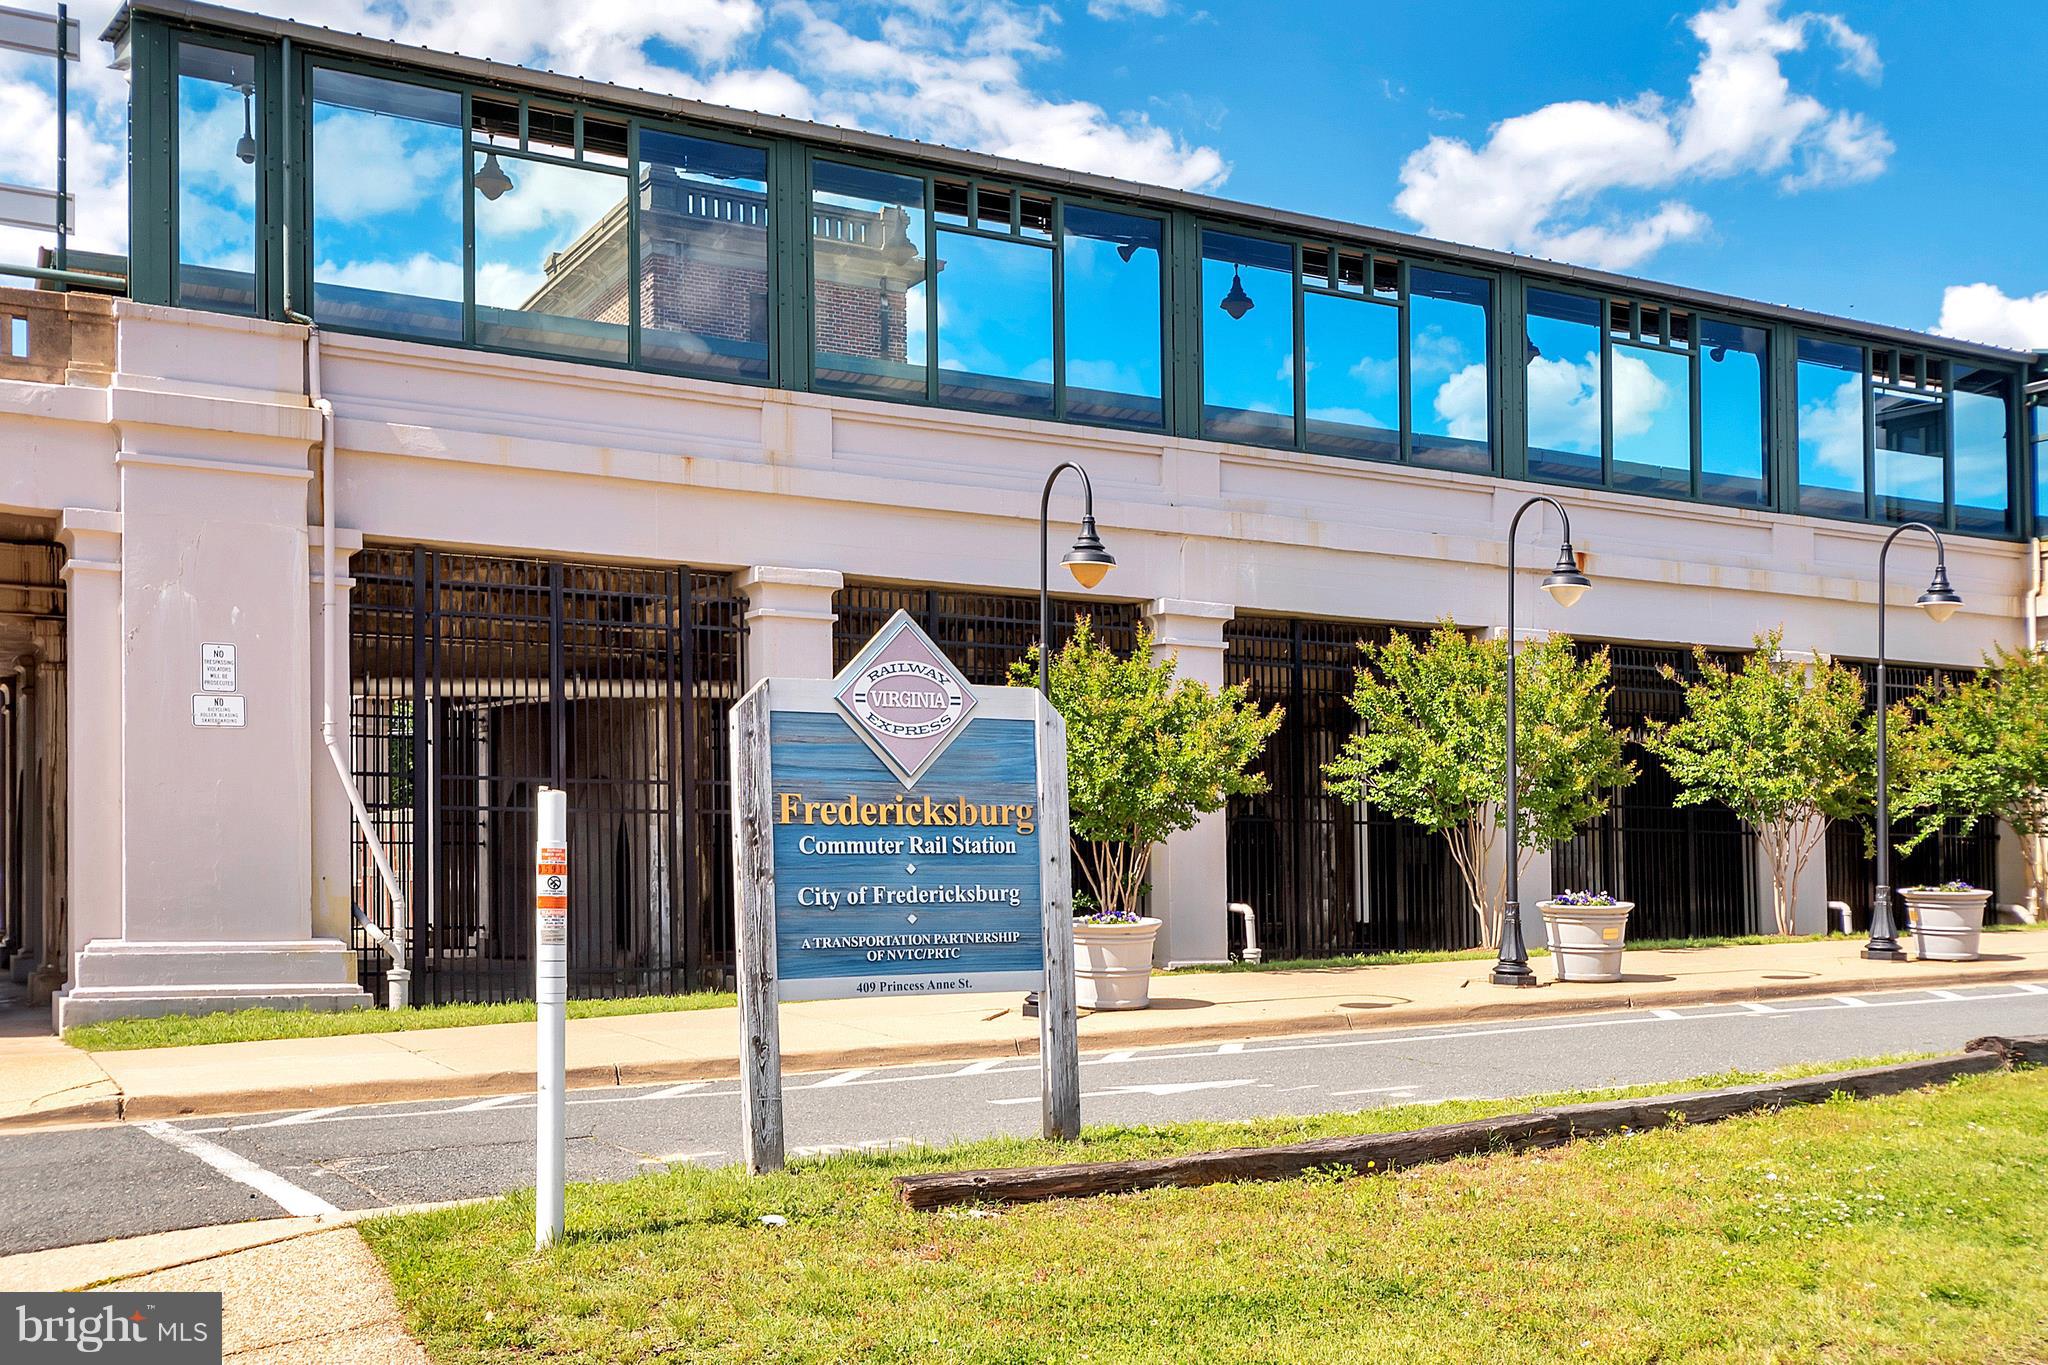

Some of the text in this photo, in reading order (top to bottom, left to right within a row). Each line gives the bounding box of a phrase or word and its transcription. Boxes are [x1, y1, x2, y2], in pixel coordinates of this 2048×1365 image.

[213, 650, 224, 658] NO
[867, 663, 951, 685] RAILWAY
[214, 698, 224, 706] NO
[870, 690, 947, 709] VIRGINIA
[865, 712, 952, 735] EXPRESS
[778, 793, 1035, 834] Fredericksburg
[798, 835, 1017, 855] Commuter Rail Station
[797, 885, 1020, 910] City of Fredericksburg
[801, 932, 1020, 949] A TRANSPORTATION PARTNERSHIP
[866, 948, 960, 962] OF NVTC/PRTC
[856, 978, 973, 993] 409 Princess Anne St.
